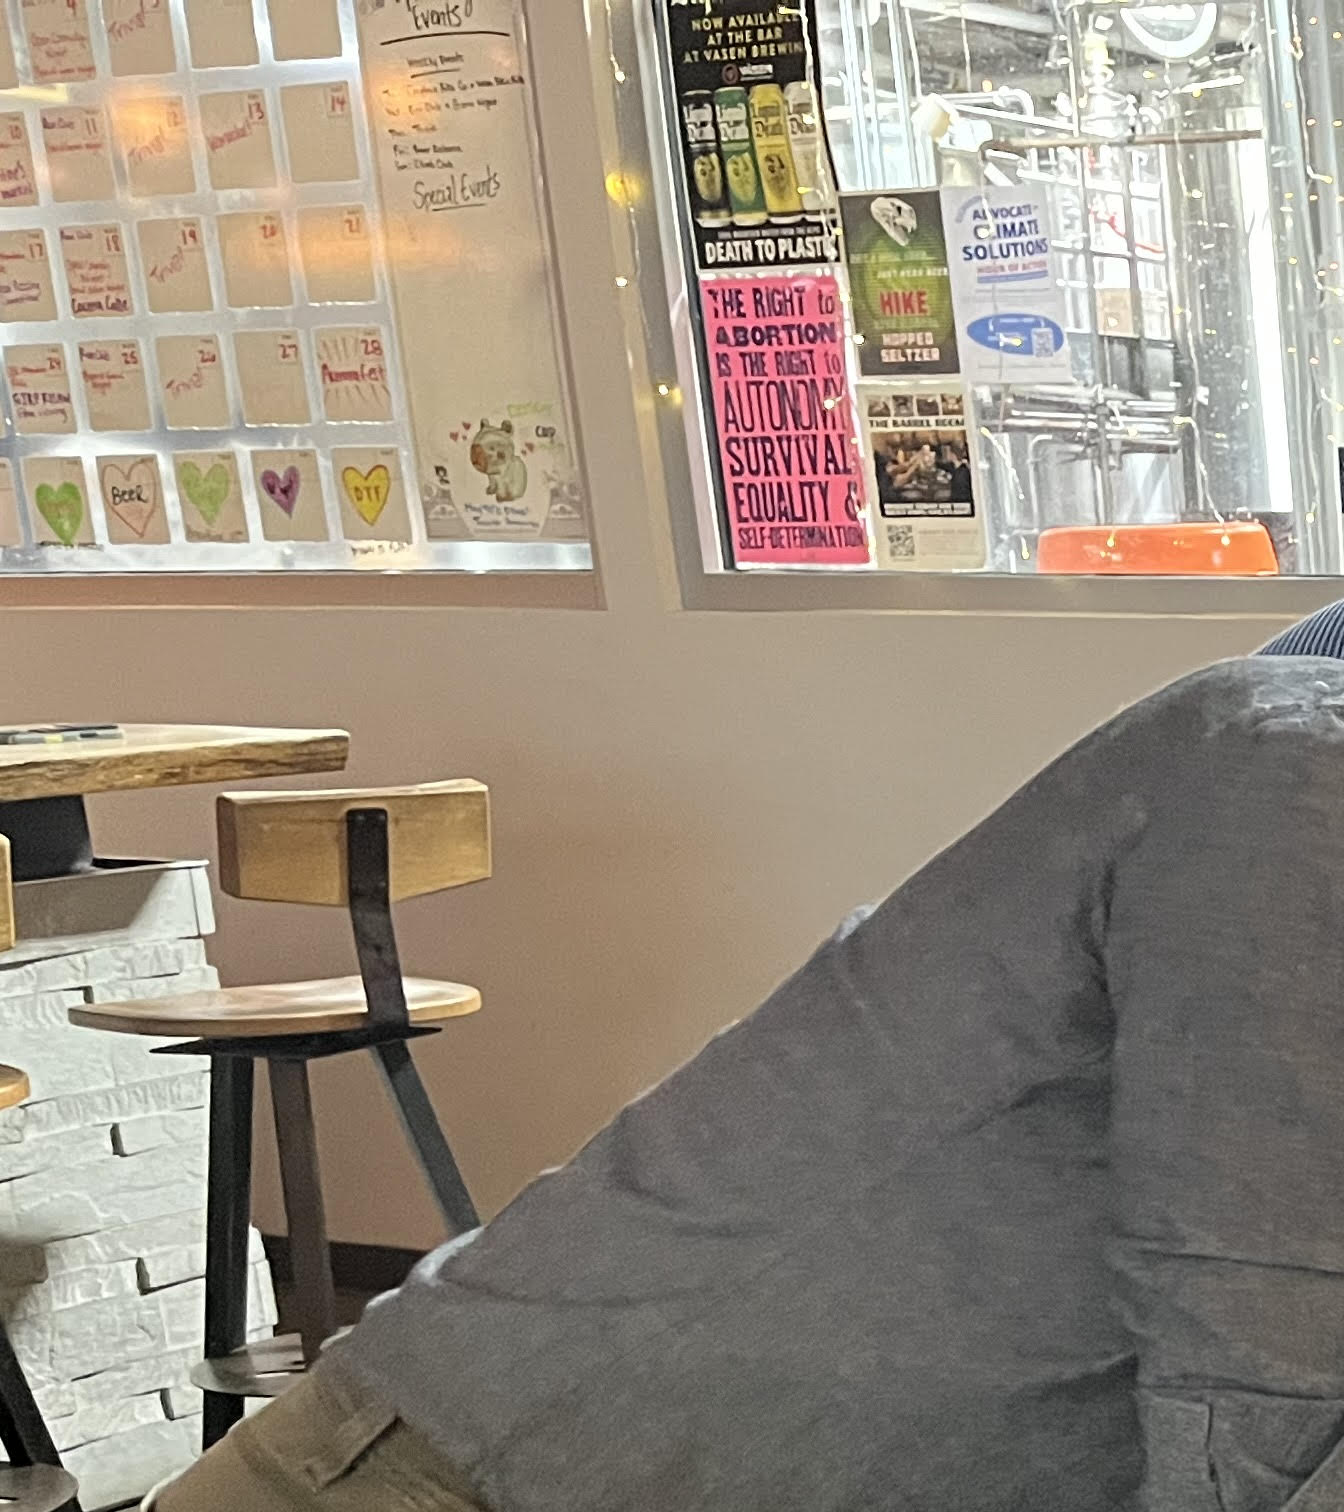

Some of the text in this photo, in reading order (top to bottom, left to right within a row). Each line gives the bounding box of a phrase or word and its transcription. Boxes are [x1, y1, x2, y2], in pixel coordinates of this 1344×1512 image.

[411, 5, 464, 30] Events
[692, 17, 723, 31] NOW
[707, 27, 783, 46] AT THE BAR
[683, 51, 699, 63] AT
[752, 41, 804, 58] BREWIN
[330, 95, 346, 112] 14
[461, 165, 501, 201] Events
[704, 240, 753, 264] DEATH
[754, 237, 777, 262] TO
[962, 238, 1049, 261] SOLUTIONS
[707, 286, 835, 318] THE RIGHT to
[880, 291, 929, 316] HIKE
[716, 322, 837, 347] ABORTION
[716, 350, 842, 377] IS THE RIGHT to
[880, 347, 940, 363] SELTZER
[724, 376, 847, 433] AUTONOMY
[725, 434, 852, 477] SURVIVAL
[733, 481, 829, 522] EQUALITY
[738, 525, 866, 549] SELF-DETERMINATION
